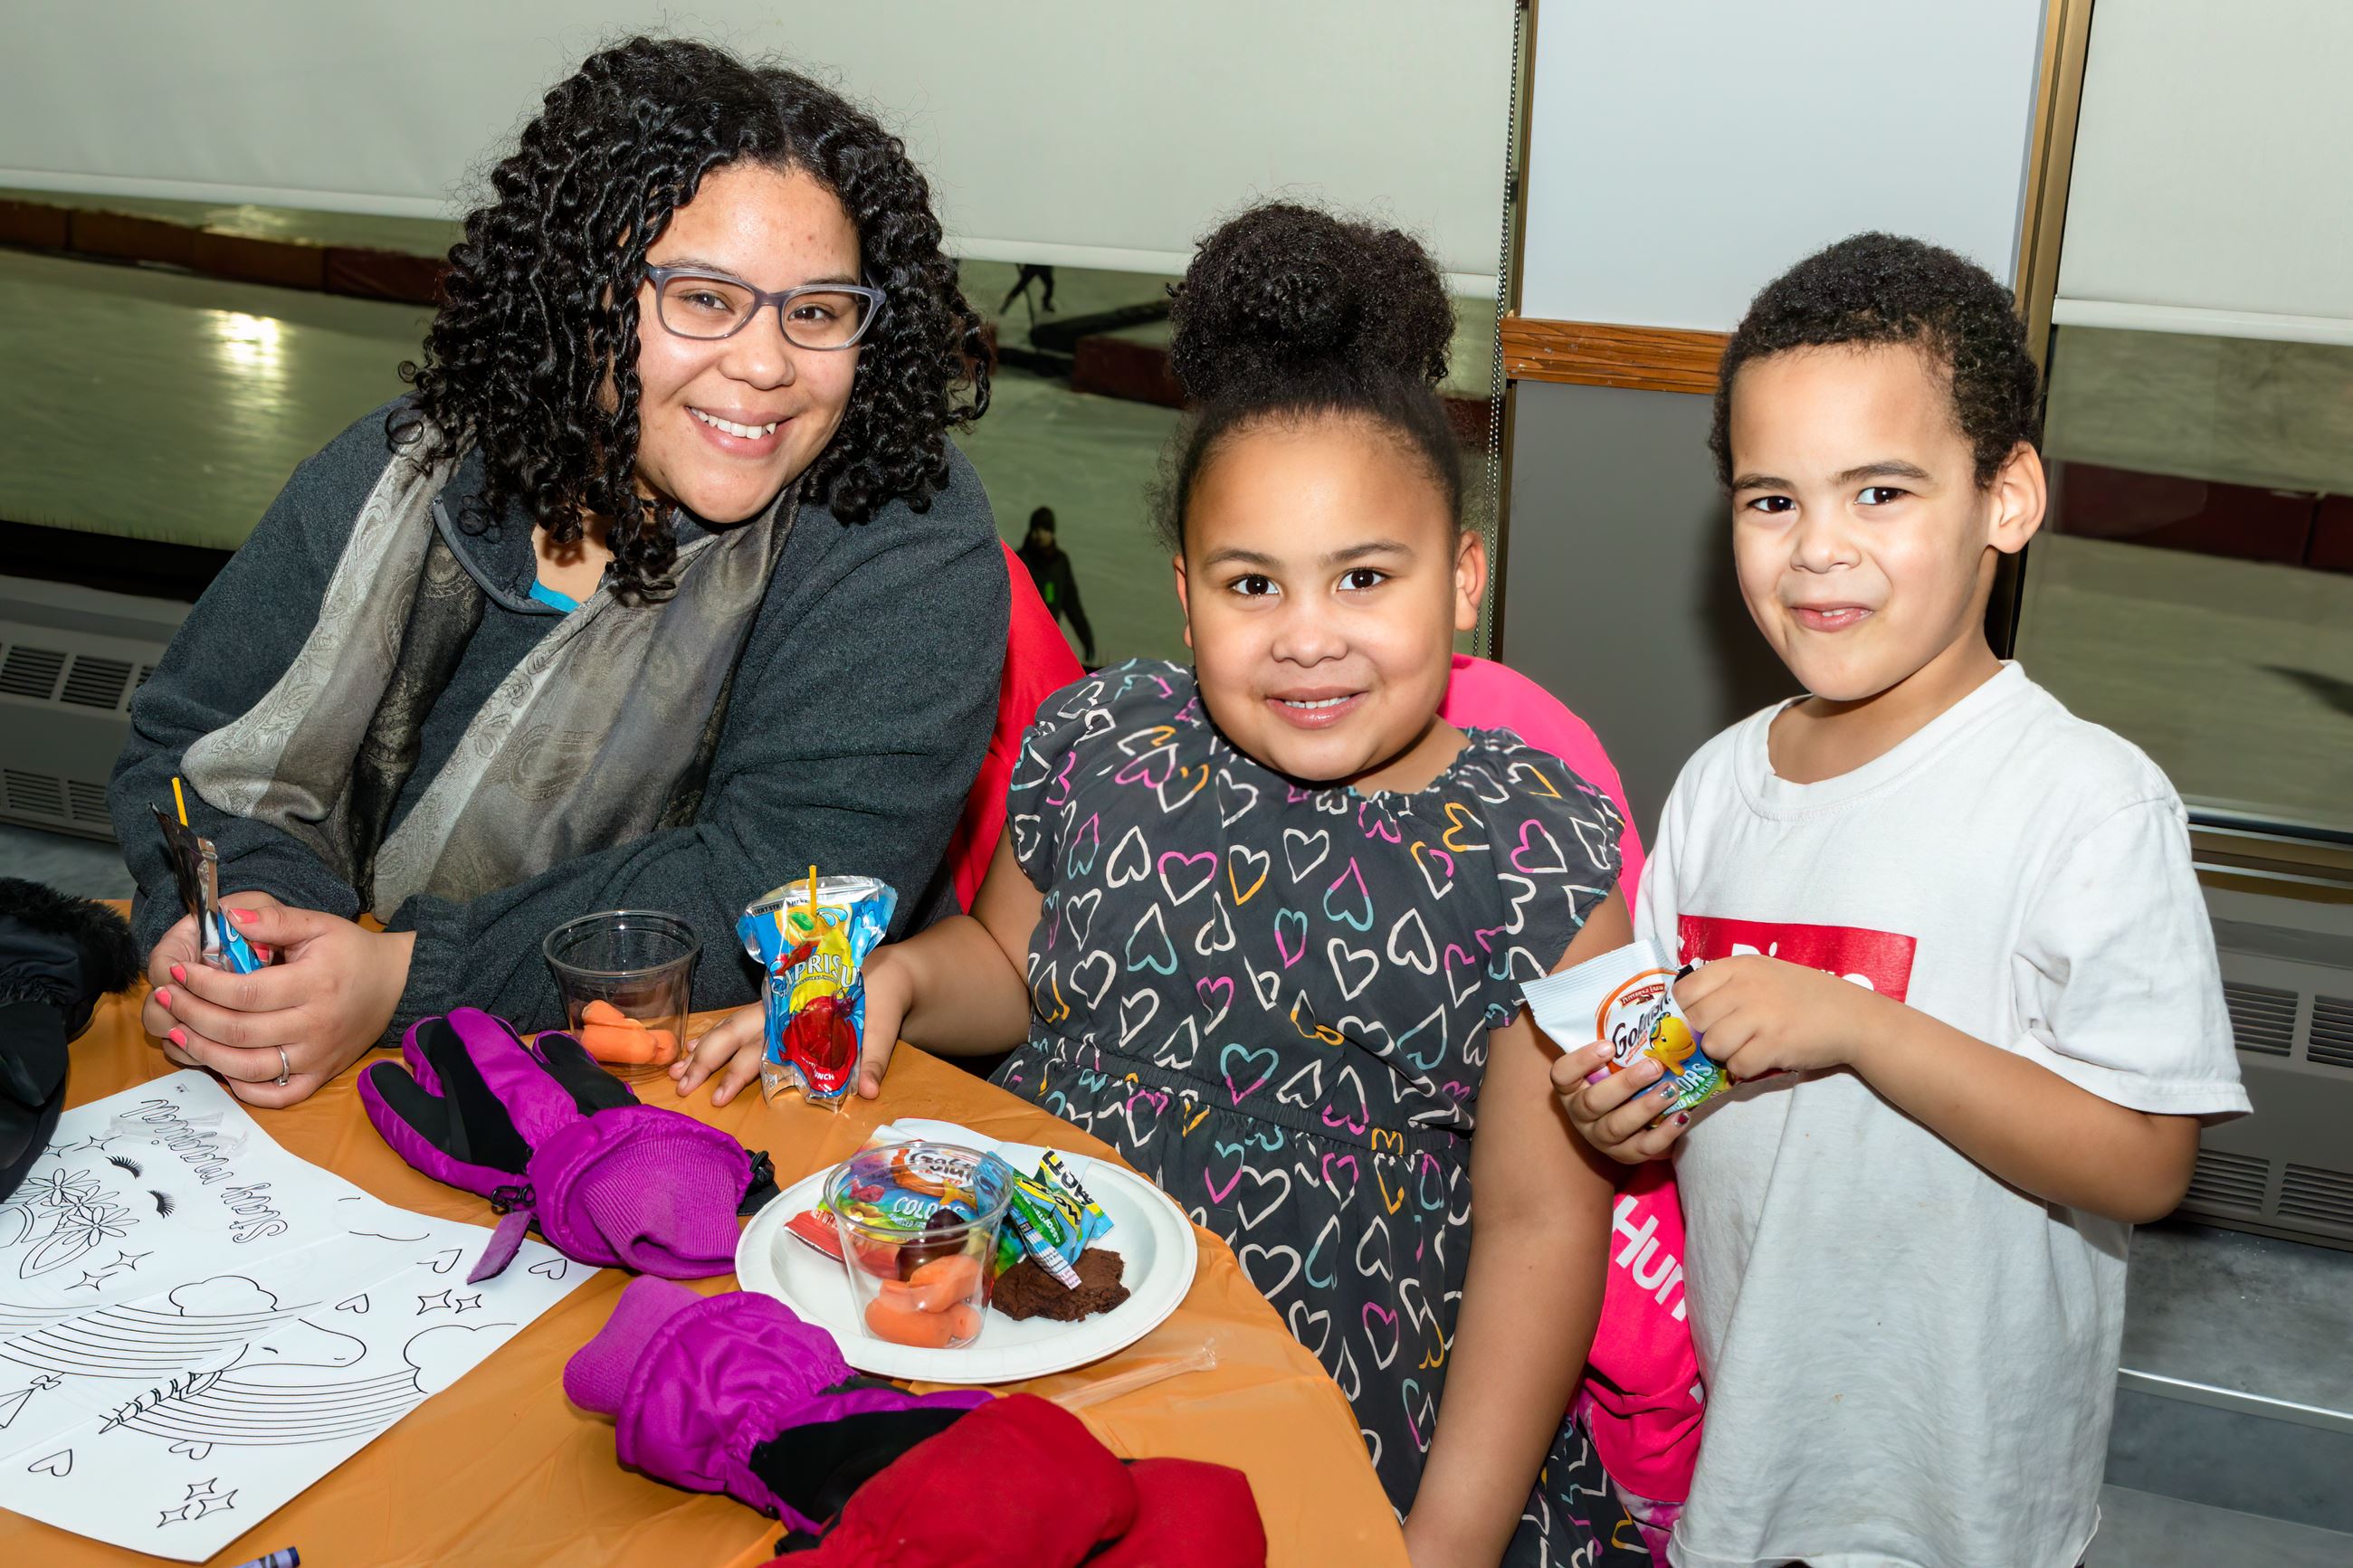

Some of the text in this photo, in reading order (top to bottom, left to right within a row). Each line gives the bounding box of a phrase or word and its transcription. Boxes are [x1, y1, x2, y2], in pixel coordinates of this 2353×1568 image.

[1675, 1063, 1713, 1096] ORS
[119, 1099, 288, 1243] Stay magical
[892, 1196, 967, 1220] COLOS
